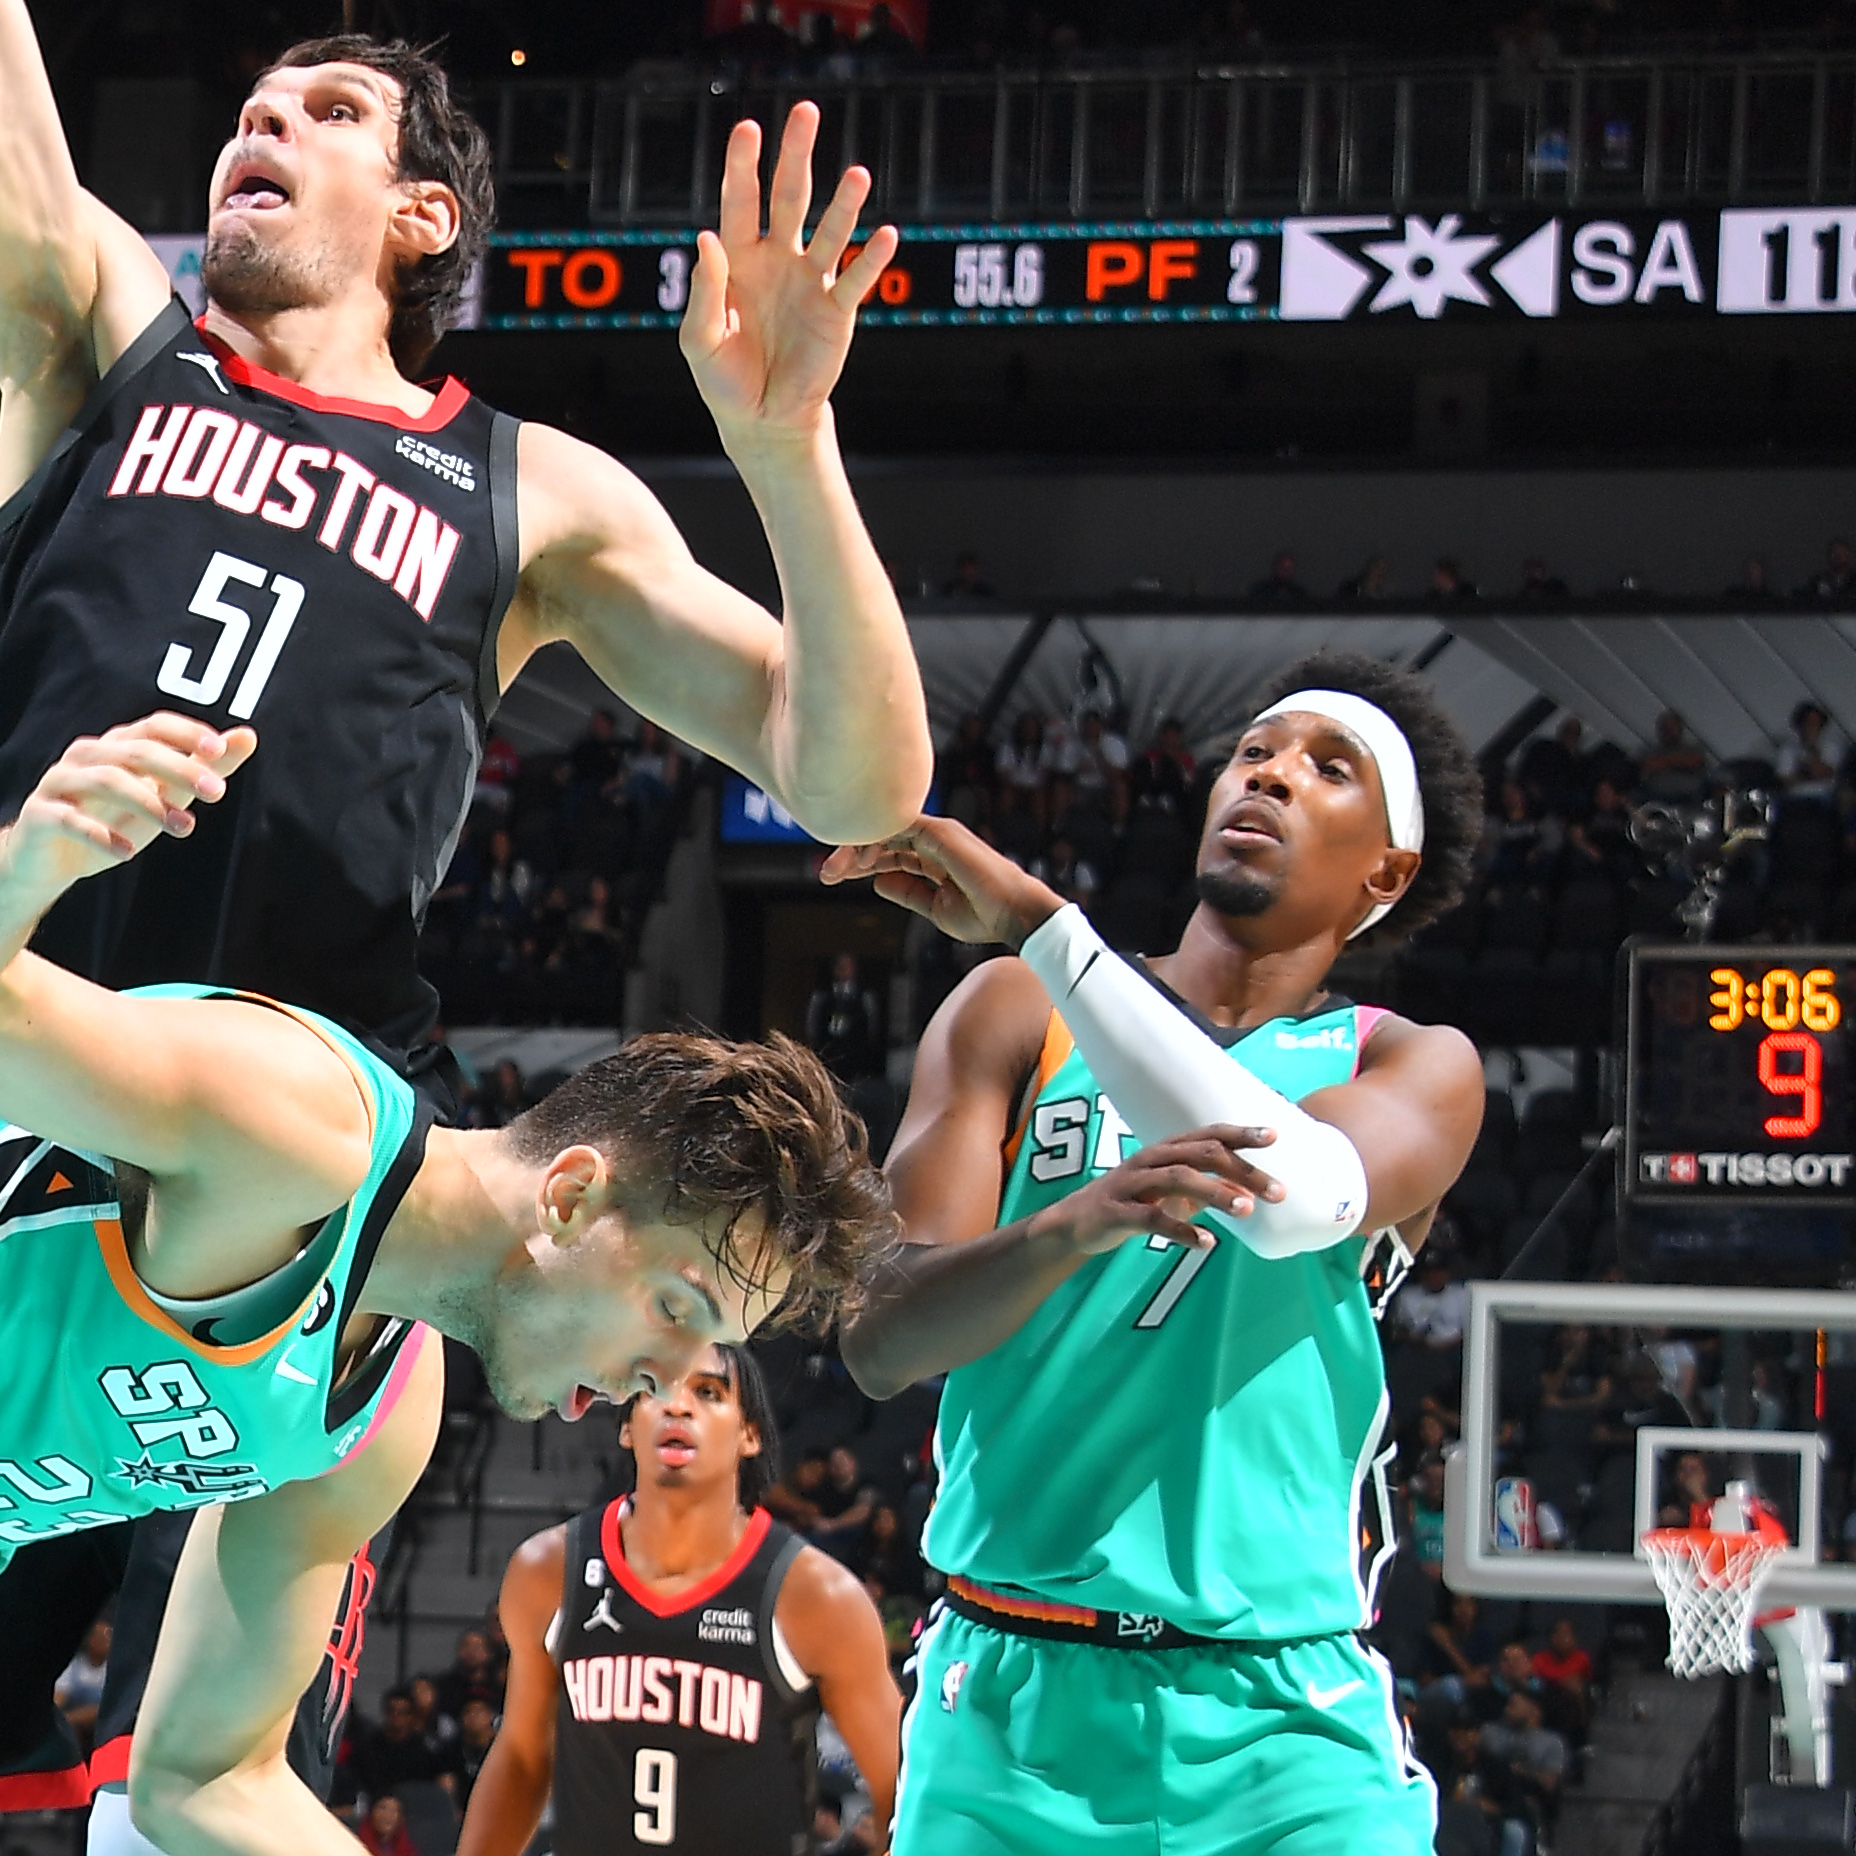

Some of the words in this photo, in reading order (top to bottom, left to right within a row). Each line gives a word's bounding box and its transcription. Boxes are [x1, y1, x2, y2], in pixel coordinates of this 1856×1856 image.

[508, 247, 625, 309] TO
[953, 242, 1044, 309] 55.6
[1085, 240, 1200, 303] PF
[1226, 239, 1257, 304] 2
[1570, 219, 1705, 307] SA
[1759, 220, 1856, 309] 11
[395, 438, 476, 492] karma
[402, 434, 474, 478] credit
[106, 404, 463, 625] HOUSTON
[155, 550, 307, 721] 51
[1708, 967, 1842, 1032] 3:06
[1758, 1032, 1823, 1138] 9
[1697, 1152, 1854, 1186] TISSOT
[584, 1557, 606, 1588] 6
[698, 1623, 757, 1646] karma
[701, 1607, 754, 1628] credit
[563, 1654, 763, 1745] HOUSTON
[633, 1747, 679, 1846] 9
